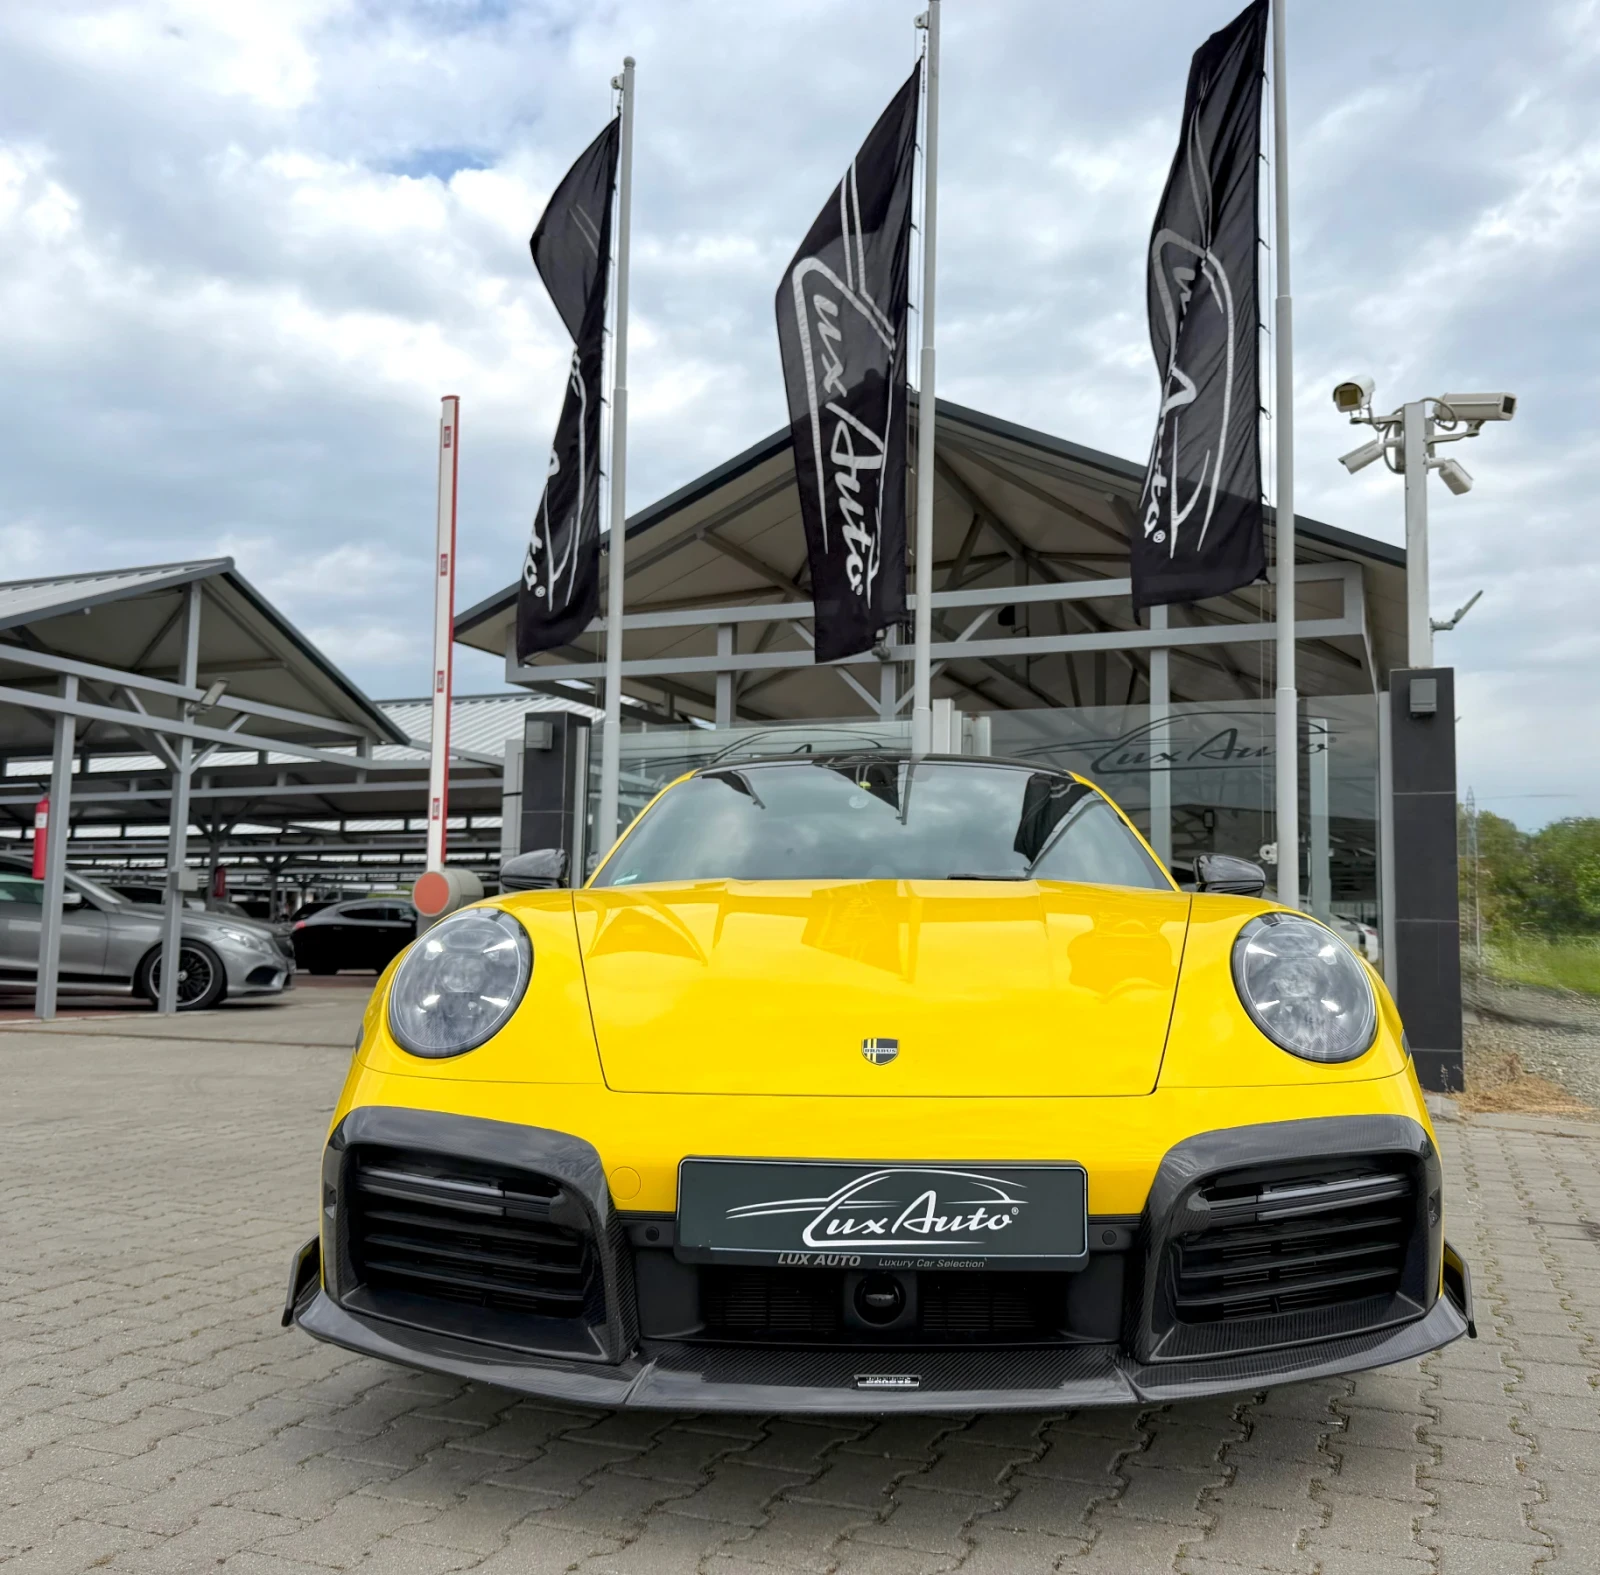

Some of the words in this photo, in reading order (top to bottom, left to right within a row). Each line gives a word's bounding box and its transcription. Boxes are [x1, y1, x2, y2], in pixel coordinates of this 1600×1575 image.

[777, 1252, 811, 1266] LUX
[813, 1254, 861, 1267] AUTO
[878, 1257, 914, 1269] Luxury
[917, 1258, 935, 1268] Car
[937, 1258, 985, 1269] Selection
